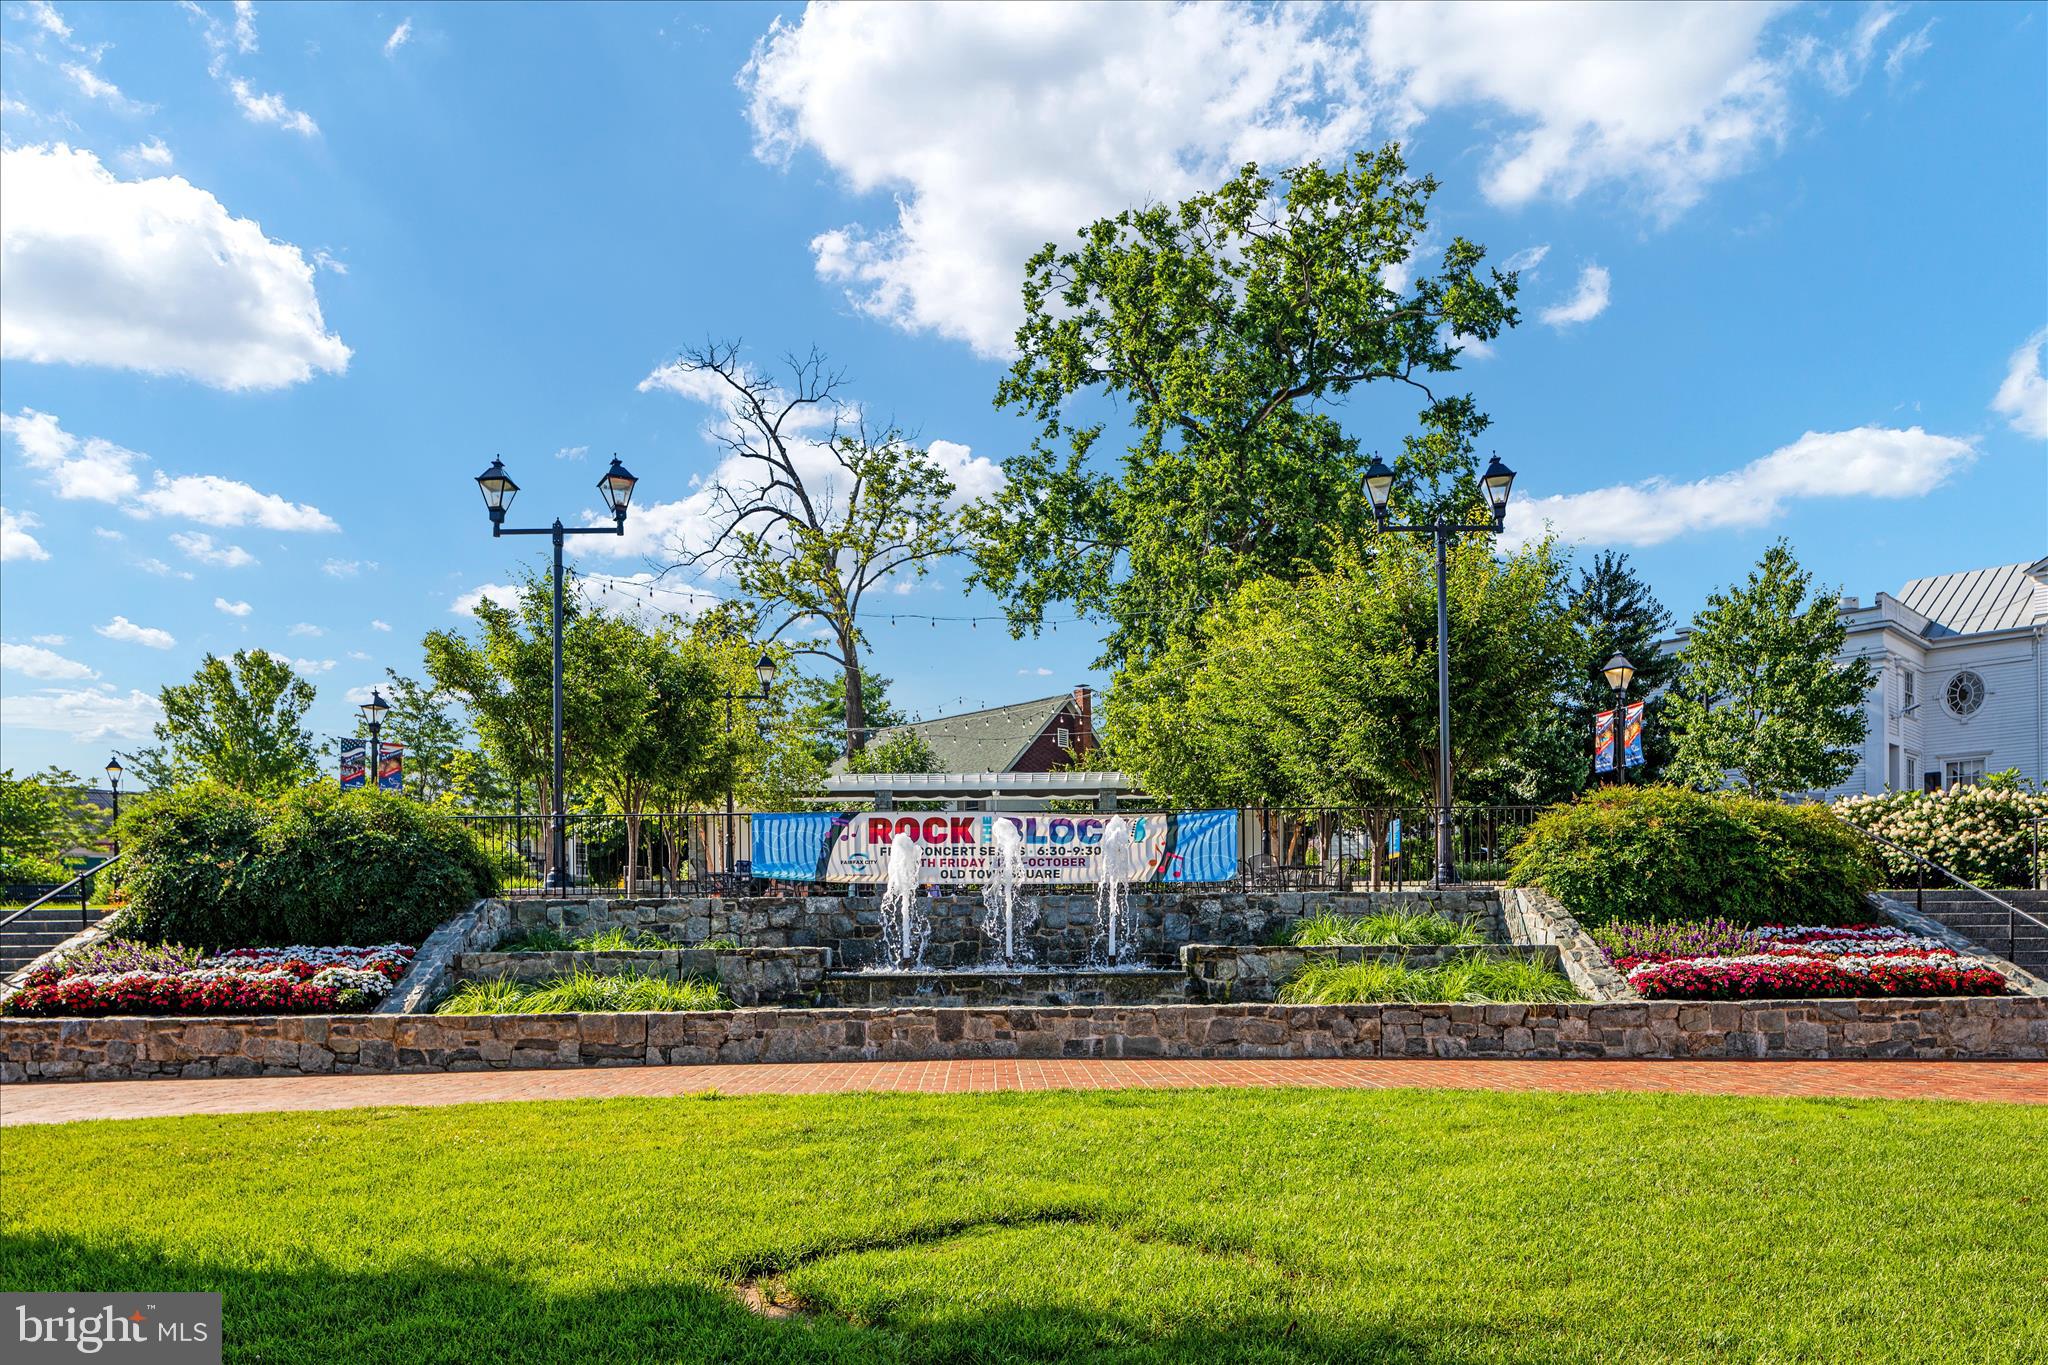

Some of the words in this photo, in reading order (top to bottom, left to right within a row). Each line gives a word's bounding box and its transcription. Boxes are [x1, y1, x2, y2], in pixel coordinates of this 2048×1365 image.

[868, 817, 976, 844] ROCK
[982, 815, 993, 844] THE
[979, 846, 1026, 856] SES
[1037, 846, 1102, 856] 6:30-9:30
[940, 858, 985, 868] FRIDAY
[940, 869, 966, 879] OLD
[969, 869, 1004, 879] TOW
